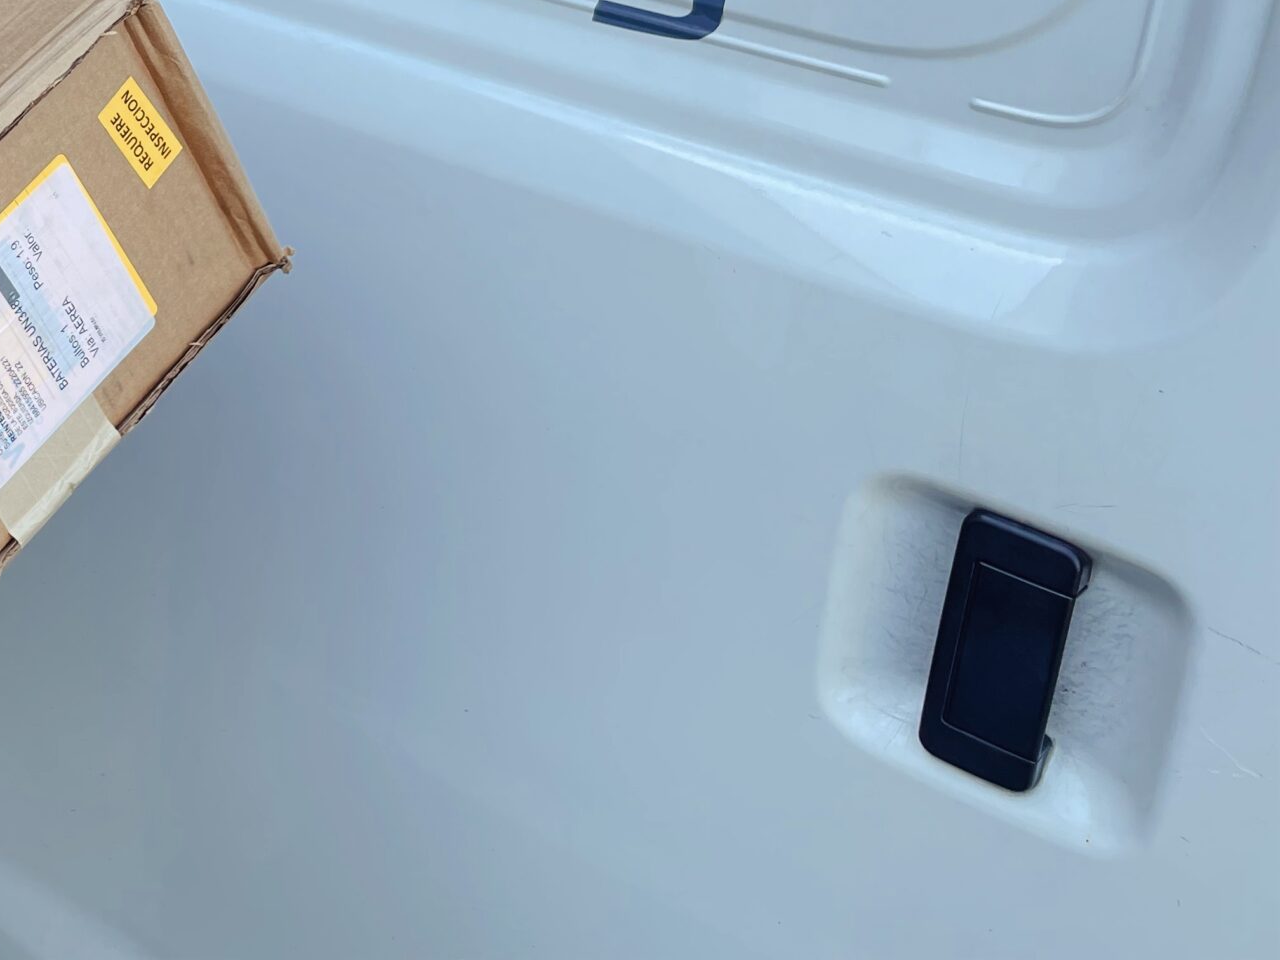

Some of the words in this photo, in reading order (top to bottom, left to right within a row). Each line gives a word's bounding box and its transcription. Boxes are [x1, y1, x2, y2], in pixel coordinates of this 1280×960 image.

[122, 91, 171, 158] INSPECCION
[111, 113, 153, 170] REQUIERE
[10, 240, 24, 258] 1.9
[24, 229, 42, 261] Valor:
[24, 258, 43, 290] Peso:
[62, 296, 87, 333] AEREA
[33, 336, 68, 390] BATERIAS
[69, 335, 89, 368] Bultos:
[1, 389, 18, 414] BODEGA
